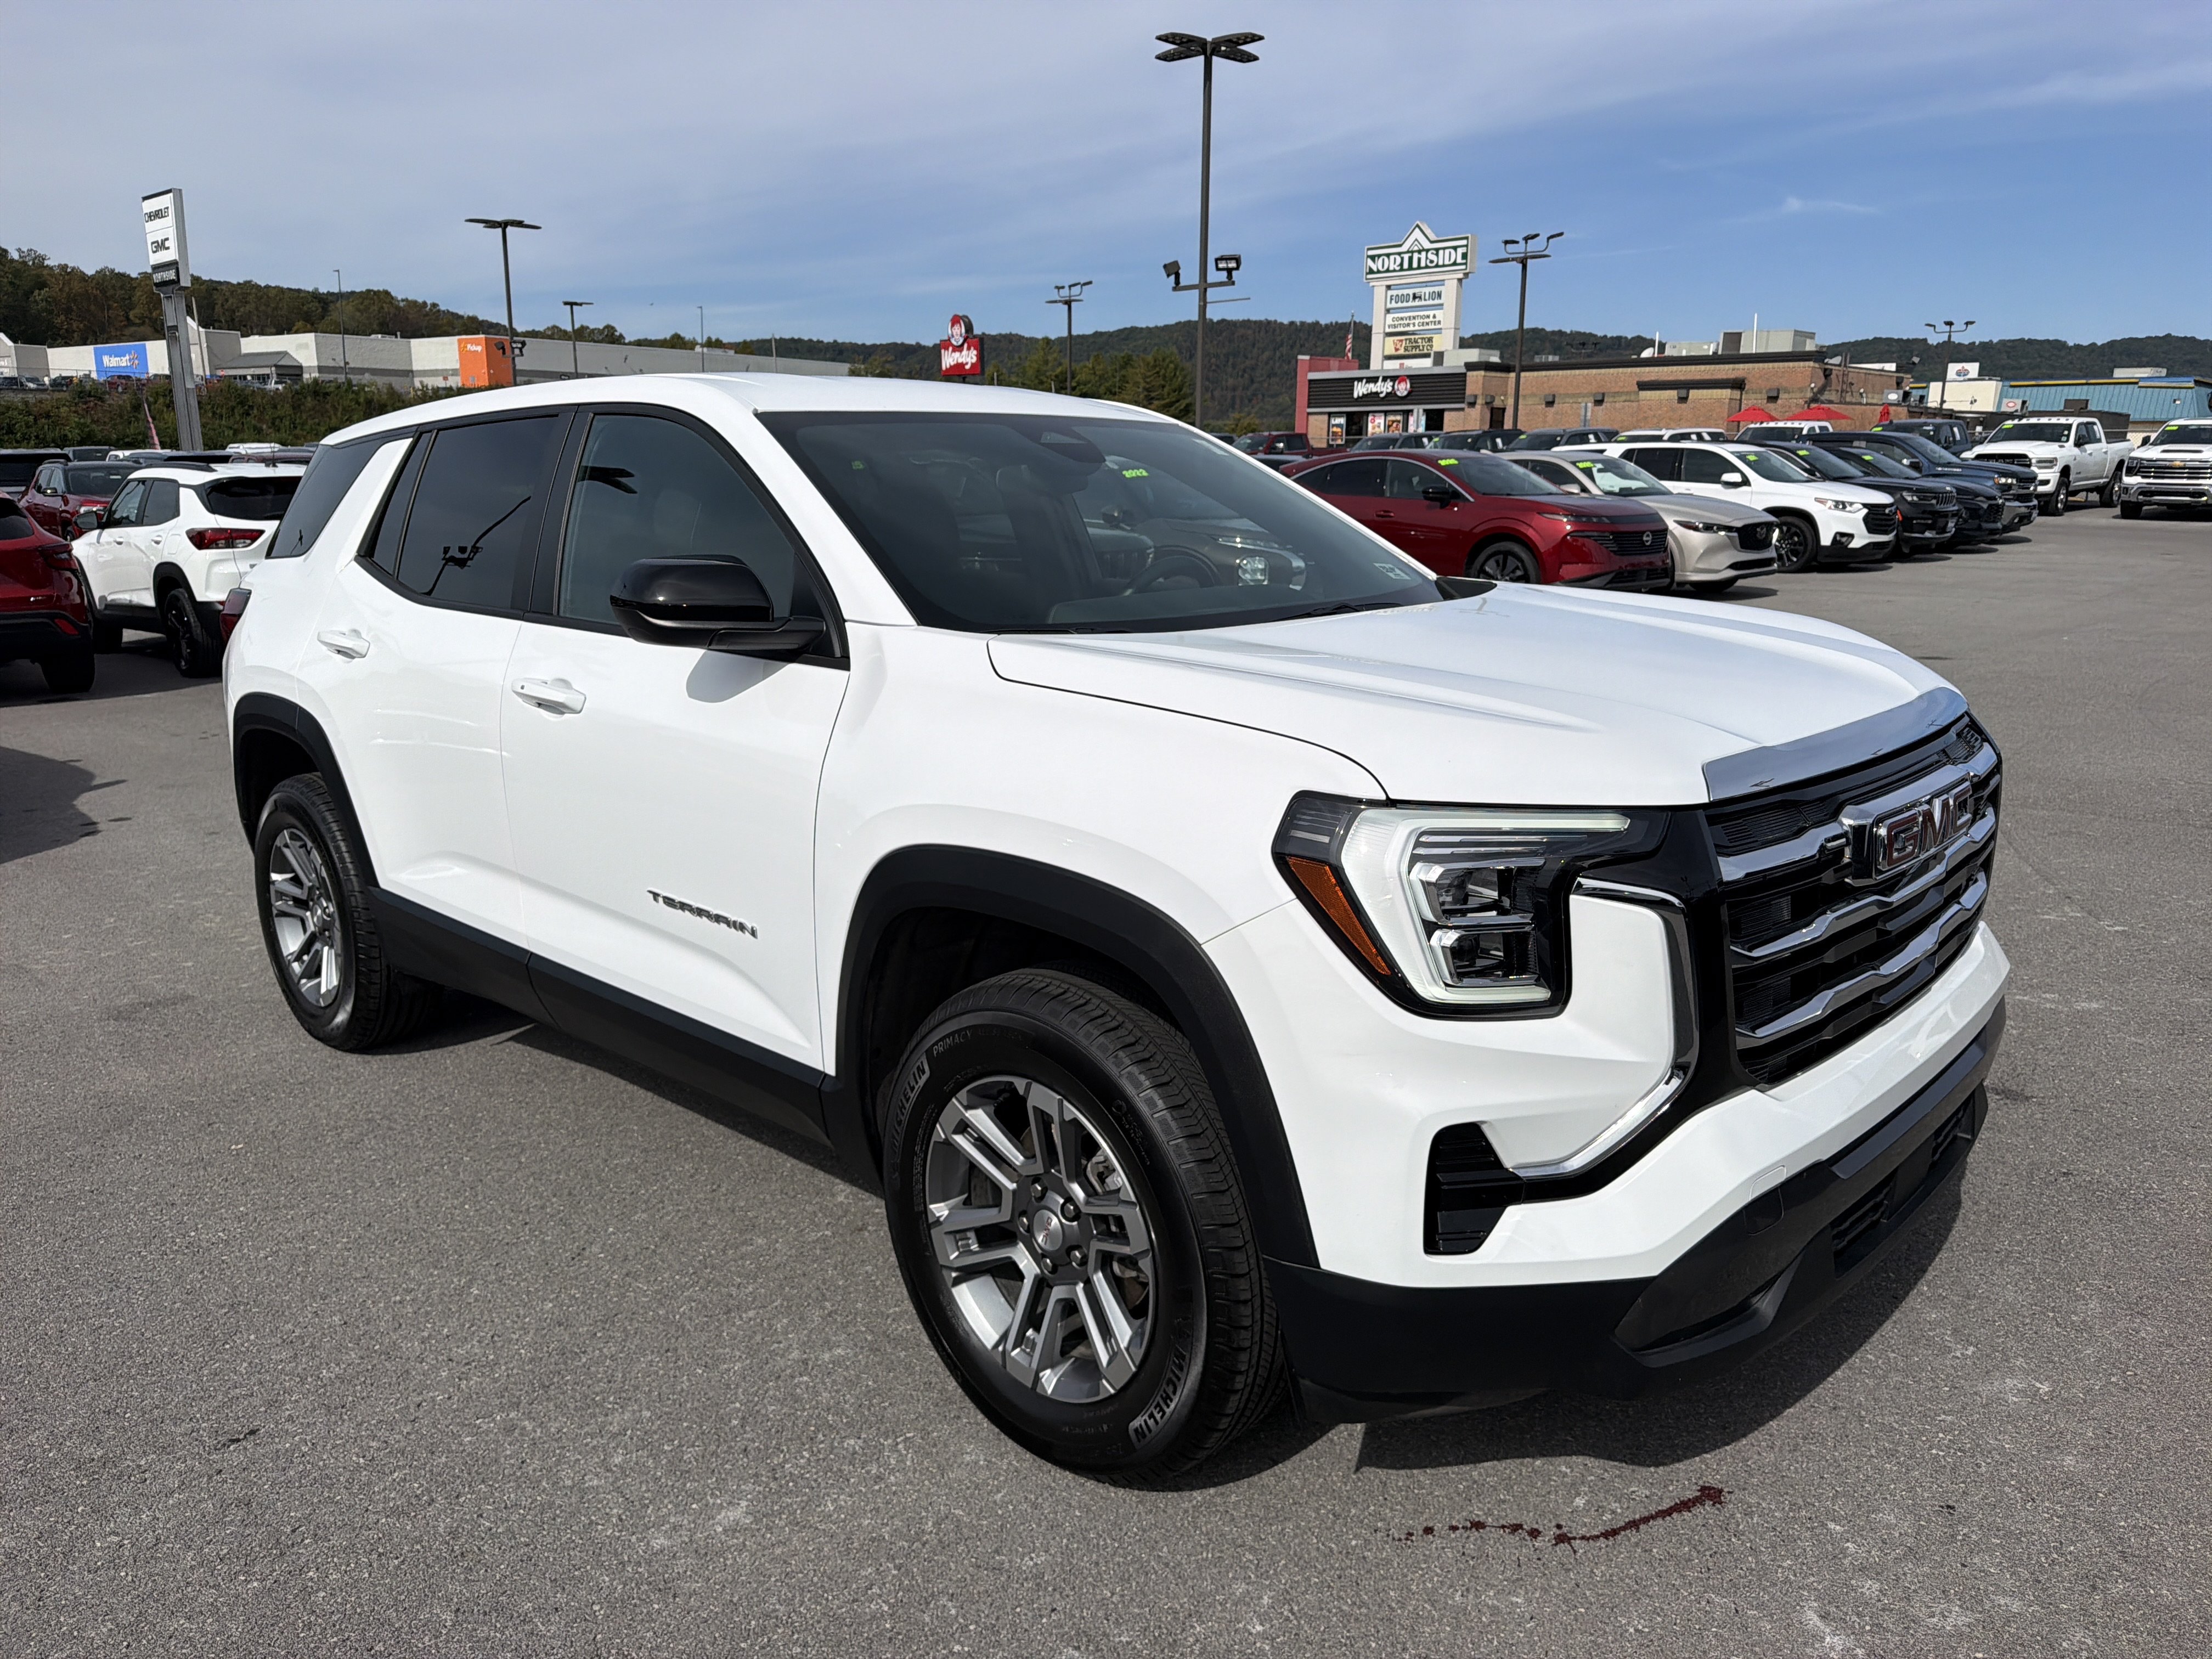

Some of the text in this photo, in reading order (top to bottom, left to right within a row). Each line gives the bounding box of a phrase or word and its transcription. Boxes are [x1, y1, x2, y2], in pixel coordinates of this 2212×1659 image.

[144, 206, 170, 223] CHEVROLET
[151, 237, 170, 253] GMC
[1367, 247, 1467, 273] NORTHSIDE
[1390, 291, 1442, 304] FOOD LION
[1392, 314, 1430, 323] CONVENTION
[1404, 336, 1434, 345] TRACTOR
[103, 354, 130, 368] Walmart
[941, 342, 977, 371] Wendy's
[1353, 376, 1393, 399] Wendy's
[1878, 781, 1973, 871] GMC
[646, 888, 758, 939] TERRAIN
[933, 1030, 973, 1057] PRIMACY
[1133, 1345, 1187, 1443] MICHELIN
